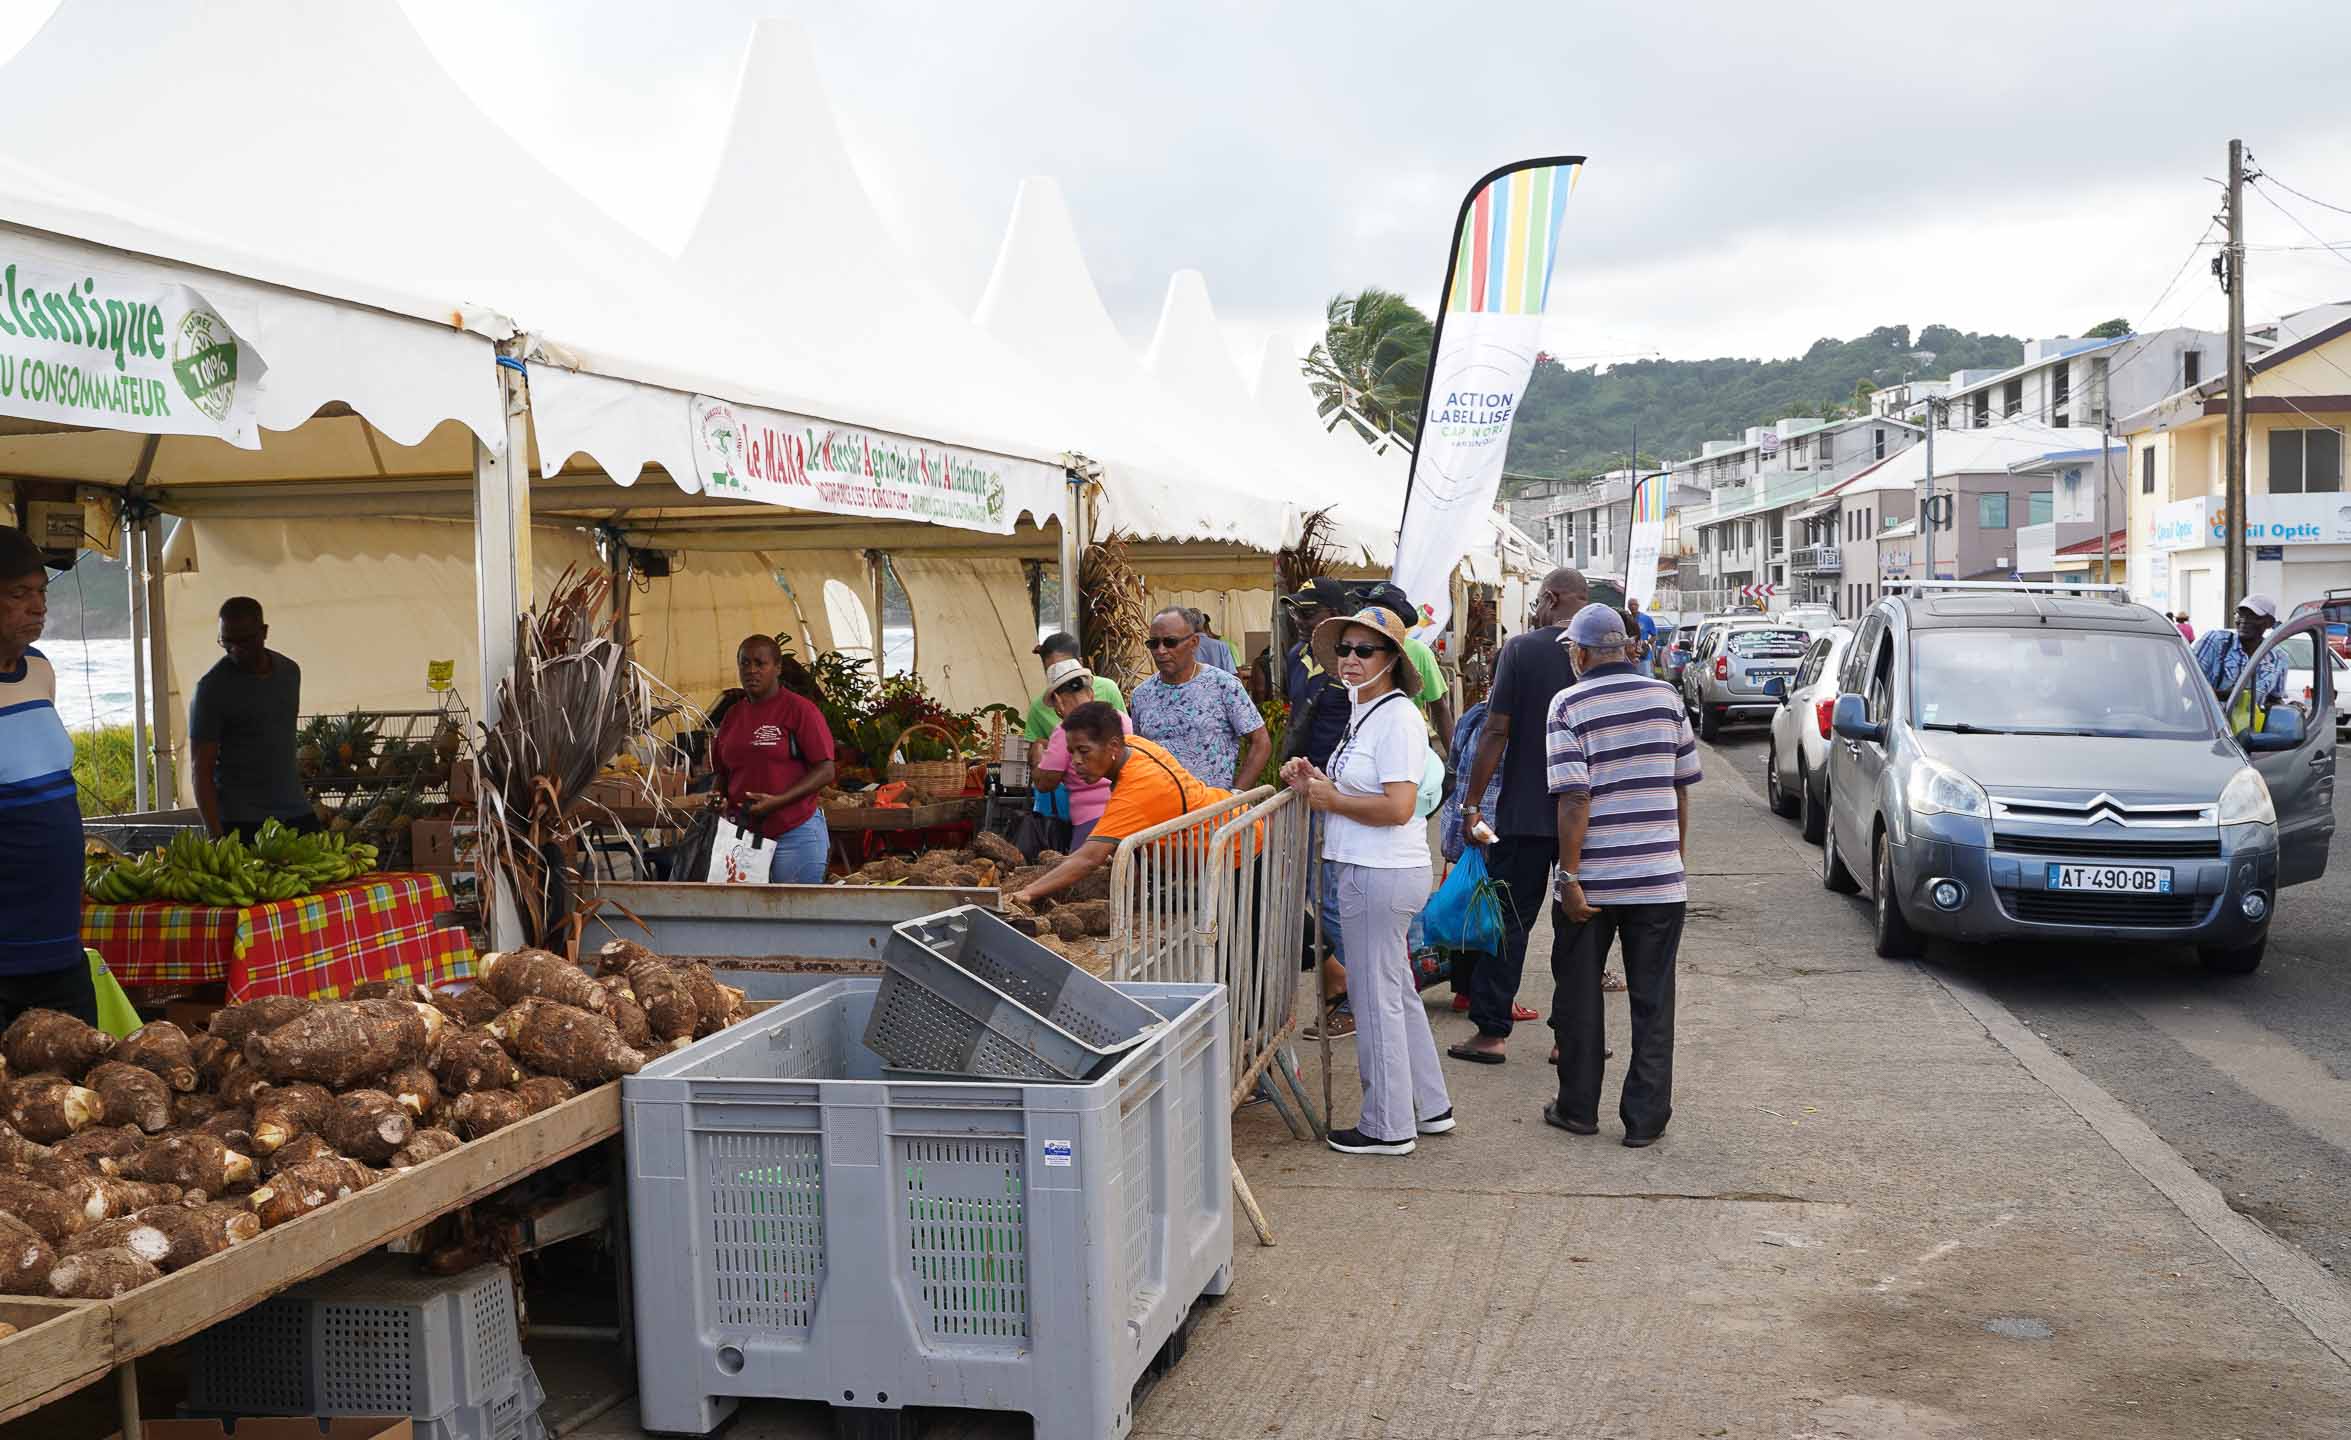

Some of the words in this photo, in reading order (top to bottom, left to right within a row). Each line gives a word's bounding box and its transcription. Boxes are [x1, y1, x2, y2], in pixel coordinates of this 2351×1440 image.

[189, 351, 229, 389] 100%
[20, 358, 171, 417] CONSOMMATEUR
[1446, 392, 1514, 408] ACTION
[1430, 407, 1512, 425] LABELLISÉ
[742, 423, 763, 480] Le
[943, 451, 986, 504] Atlantique
[2271, 522, 2321, 541] Optic
